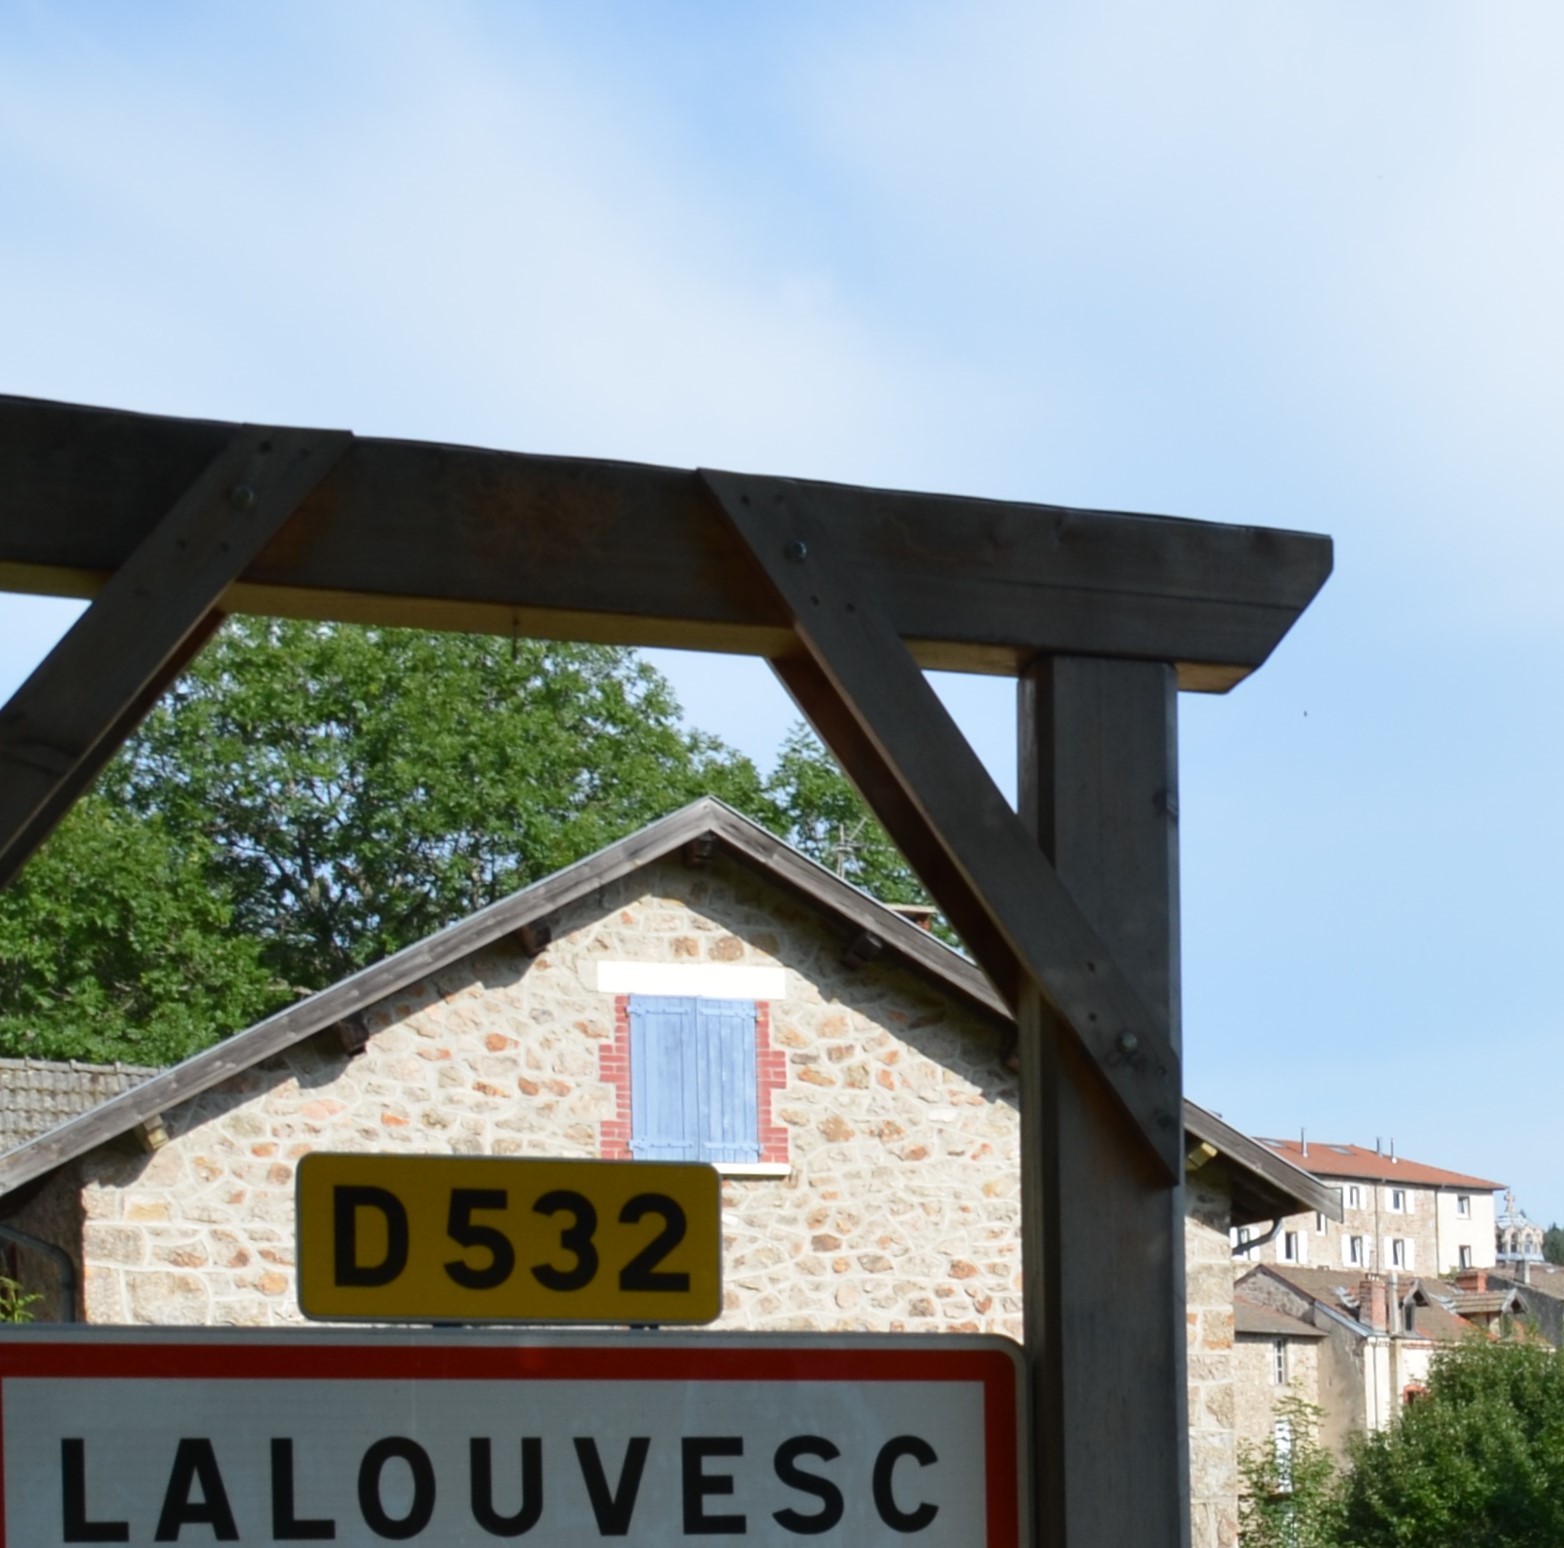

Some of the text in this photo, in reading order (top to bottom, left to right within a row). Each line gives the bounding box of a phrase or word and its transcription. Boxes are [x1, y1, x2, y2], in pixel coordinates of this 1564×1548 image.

[331, 1182, 692, 1294] D 532
[60, 1434, 941, 1544] LALOUVESC
